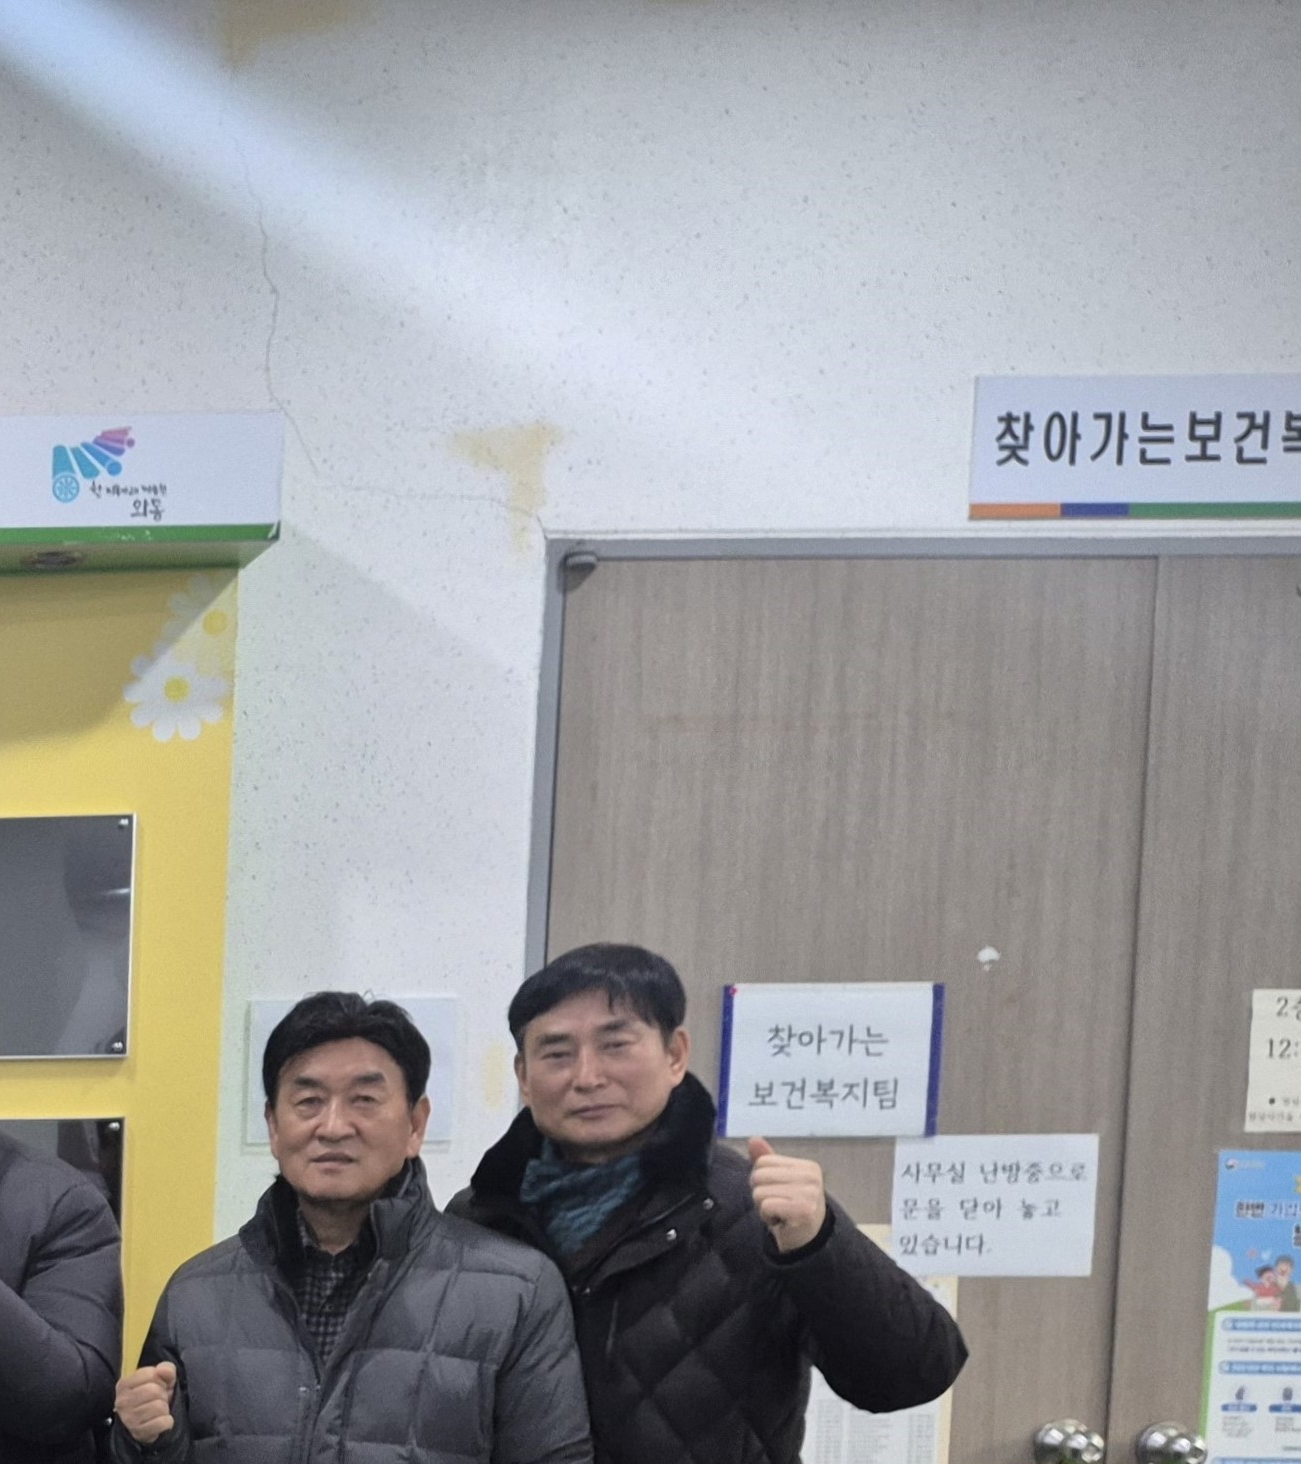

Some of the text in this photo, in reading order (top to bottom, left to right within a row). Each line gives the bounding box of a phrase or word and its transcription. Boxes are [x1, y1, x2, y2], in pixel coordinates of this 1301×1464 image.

[130, 498, 165, 521] 와동
[766, 1023, 889, 1056] 찾아가는
[748, 1077, 900, 1110] 보건복지팀
[901, 1161, 1088, 1185] 사무실 난방중으로
[899, 1198, 1063, 1221] 문을 닫아 놓고
[899, 1232, 992, 1257] 있습니다.
